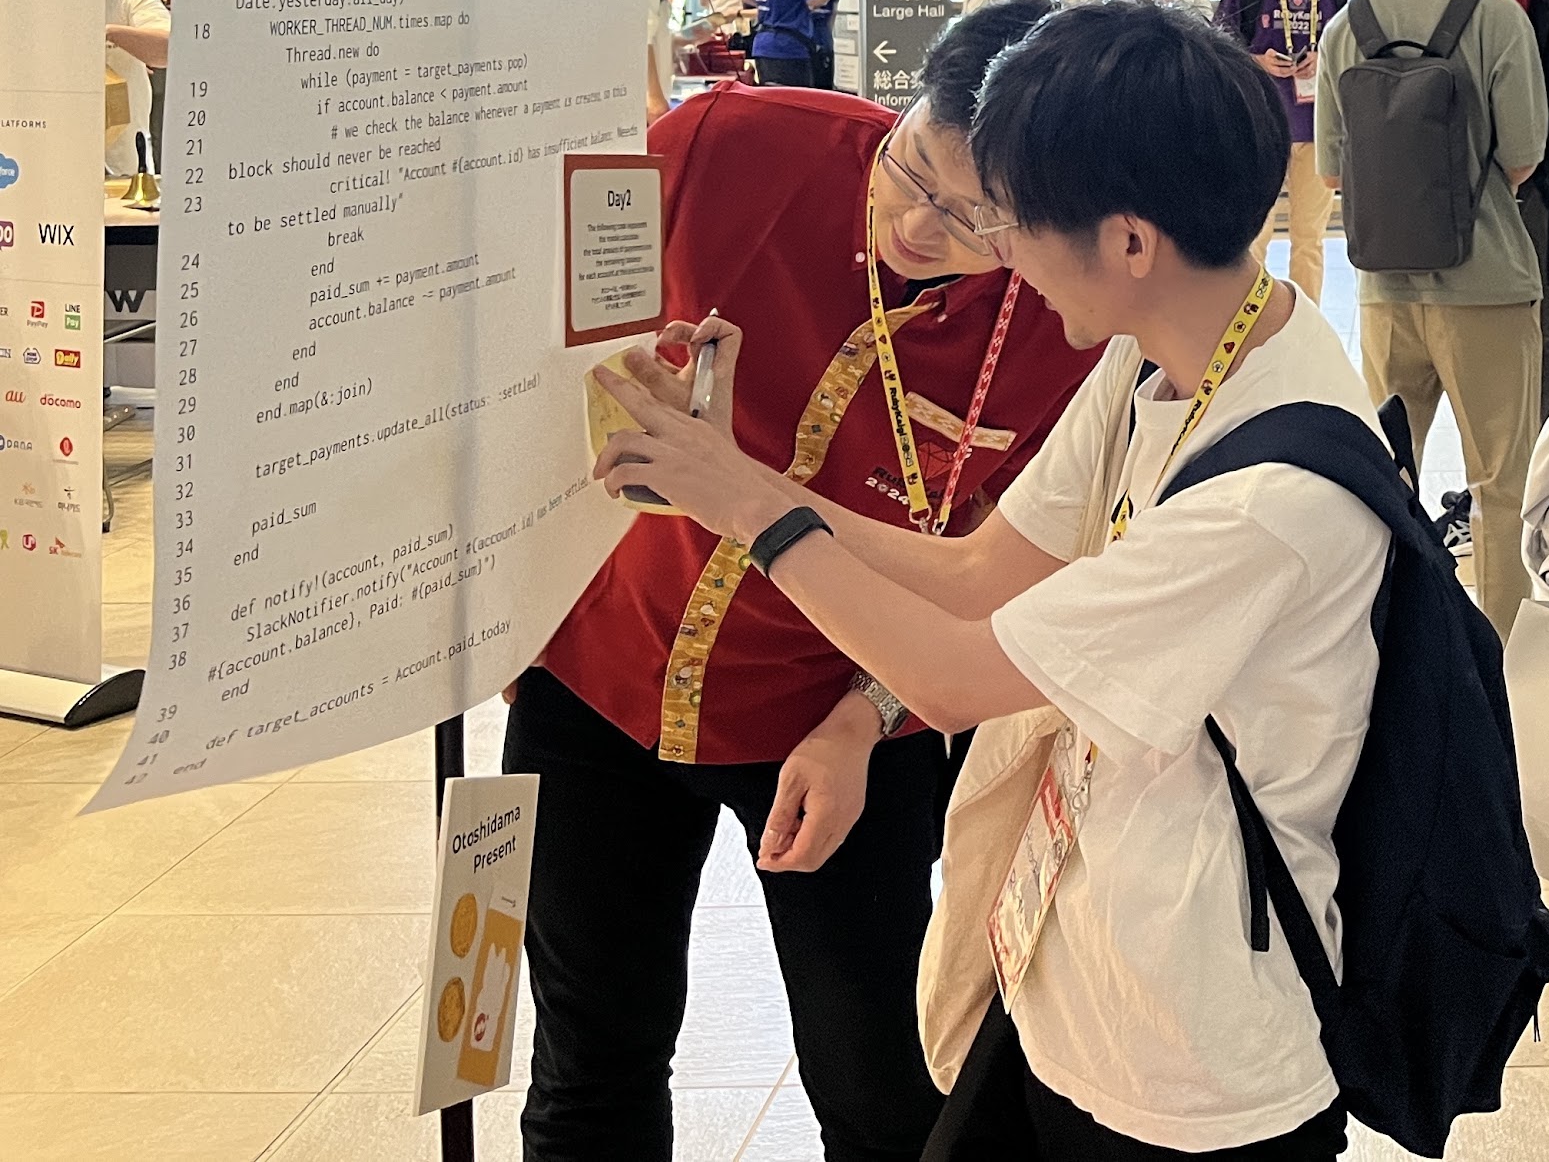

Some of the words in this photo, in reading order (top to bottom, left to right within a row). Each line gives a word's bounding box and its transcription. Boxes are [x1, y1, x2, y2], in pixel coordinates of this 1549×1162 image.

[873, 4, 913, 20] Large
[917, 4, 944, 17] Hall
[193, 23, 211, 40] 18
[270, 14, 452, 36] WORKER_THREAD_NUM.times.map
[458, 11, 470, 26] do
[286, 44, 359, 64] Thread.new
[366, 43, 380, 57] do
[301, 72, 338, 89] while
[346, 66, 398, 88] (payment
[417, 54, 528, 79] target_payments.pop)
[190, 82, 208, 98] 19
[317, 99, 330, 115] if
[338, 89, 435, 113] account.balance
[452, 78, 528, 104] payment.amount
[345, 124, 359, 138] we
[366, 118, 397, 136] check
[405, 113, 423, 130] the
[428, 108, 469, 127] balance
[475, 101, 517, 122] whenever
[186, 139, 203, 156] 21
[228, 161, 273, 180] block
[283, 154, 330, 174] should
[337, 149, 372, 167] never
[379, 145, 392, 160] be
[399, 137, 441, 157] reached
[330, 171, 390, 194] critical!
[398, 162, 446, 183] "Account
[544, 136, 587, 156] insufficient
[185, 167, 204, 185] 22
[184, 197, 203, 214] 23
[608, 189, 631, 210] Day2
[228, 220, 245, 236] to
[254, 214, 271, 232] be
[280, 203, 336, 229] settled
[344, 193, 404, 221] manually"
[38, 223, 75, 245] WIX
[328, 228, 364, 247] break
[311, 260, 335, 277] end
[310, 279, 370, 306] paid_sum
[396, 253, 479, 286] payment.amount
[180, 283, 199, 300] 25
[309, 294, 415, 331] account.balance
[440, 267, 516, 301] payment.amount
[65, 304, 80, 313] LINE
[27, 320, 48, 328] PayPay
[66, 316, 79, 328] Pay
[180, 311, 199, 329] 26
[180, 340, 197, 358] 27
[293, 342, 316, 361] end
[179, 369, 197, 386] 28
[275, 373, 299, 392] end
[5, 390, 26, 403] au
[40, 396, 81, 409] docomo
[178, 397, 196, 414] 29
[256, 377, 373, 424] end.map(&:join)
[889, 387, 907, 436] RubyKaigi
[256, 394, 491, 479] target_payments.update_all(status:
[498, 373, 541, 402] :settled)
[176, 454, 193, 471] 31
[175, 511, 193, 529] 33
[252, 501, 317, 536] paid_sum
[234, 546, 260, 566] end
[230, 599, 255, 622] def
[264, 554, 385, 609] notify!(account,
[393, 524, 454, 558] paid_sum)
[247, 546, 459, 643] SlackNotifier.notify("Account
[173, 596, 191, 613] 36
[172, 623, 189, 642] 37
[208, 611, 362, 683] #{account.balance},
[369, 595, 404, 620] Paid:
[168, 651, 187, 670] 38
[206, 729, 237, 751] def
[247, 683, 374, 739] target_accounts
[395, 618, 512, 683] Account.paid_today
[221, 679, 250, 702] end
[157, 705, 178, 722] 39
[173, 758, 208, 776] end
[452, 806, 521, 854] Otoshidama
[473, 835, 516, 874] Present
